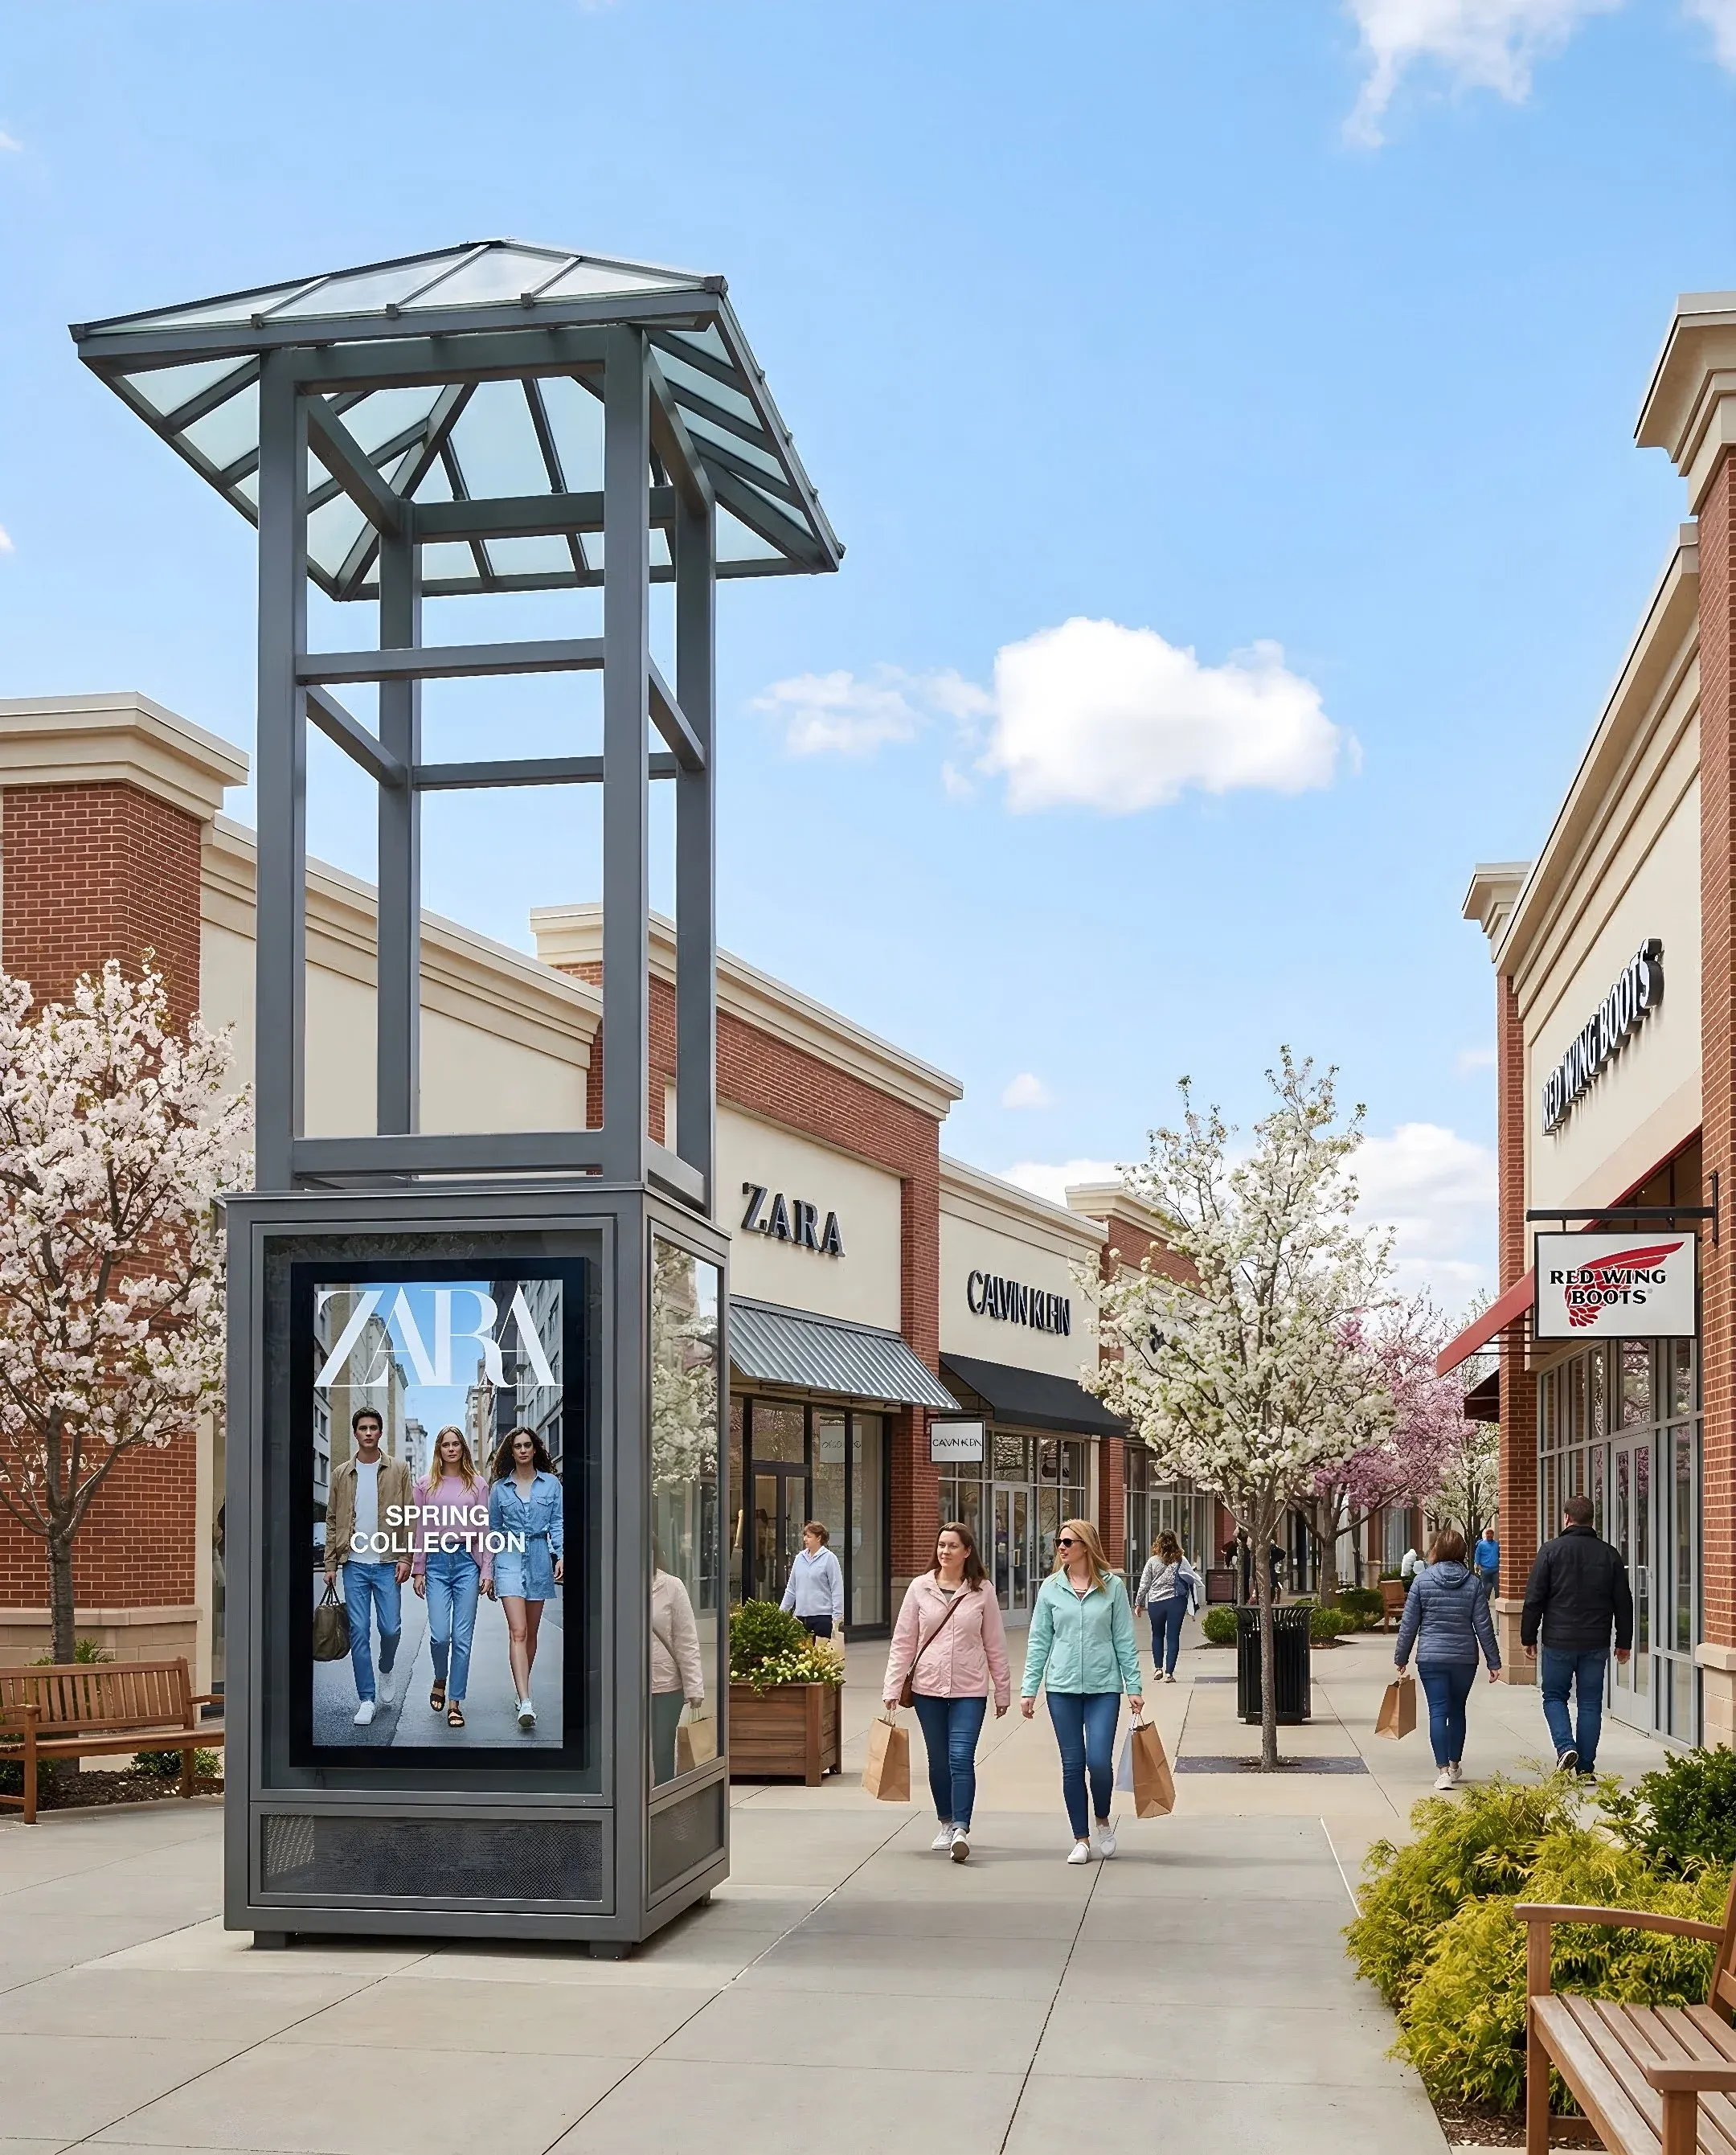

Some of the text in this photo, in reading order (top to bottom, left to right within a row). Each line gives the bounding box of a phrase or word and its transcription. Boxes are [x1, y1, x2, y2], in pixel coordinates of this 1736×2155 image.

[1542, 939, 1664, 1136] RED WING BOOTS
[740, 1182, 845, 1257] ZARA
[1550, 1269, 1668, 1284] RED WING
[1570, 1289, 1647, 1305] BOOTS
[313, 1284, 563, 1388] ZARA
[384, 1504, 490, 1527] SPRING
[350, 1531, 526, 1554] COLLECTION
